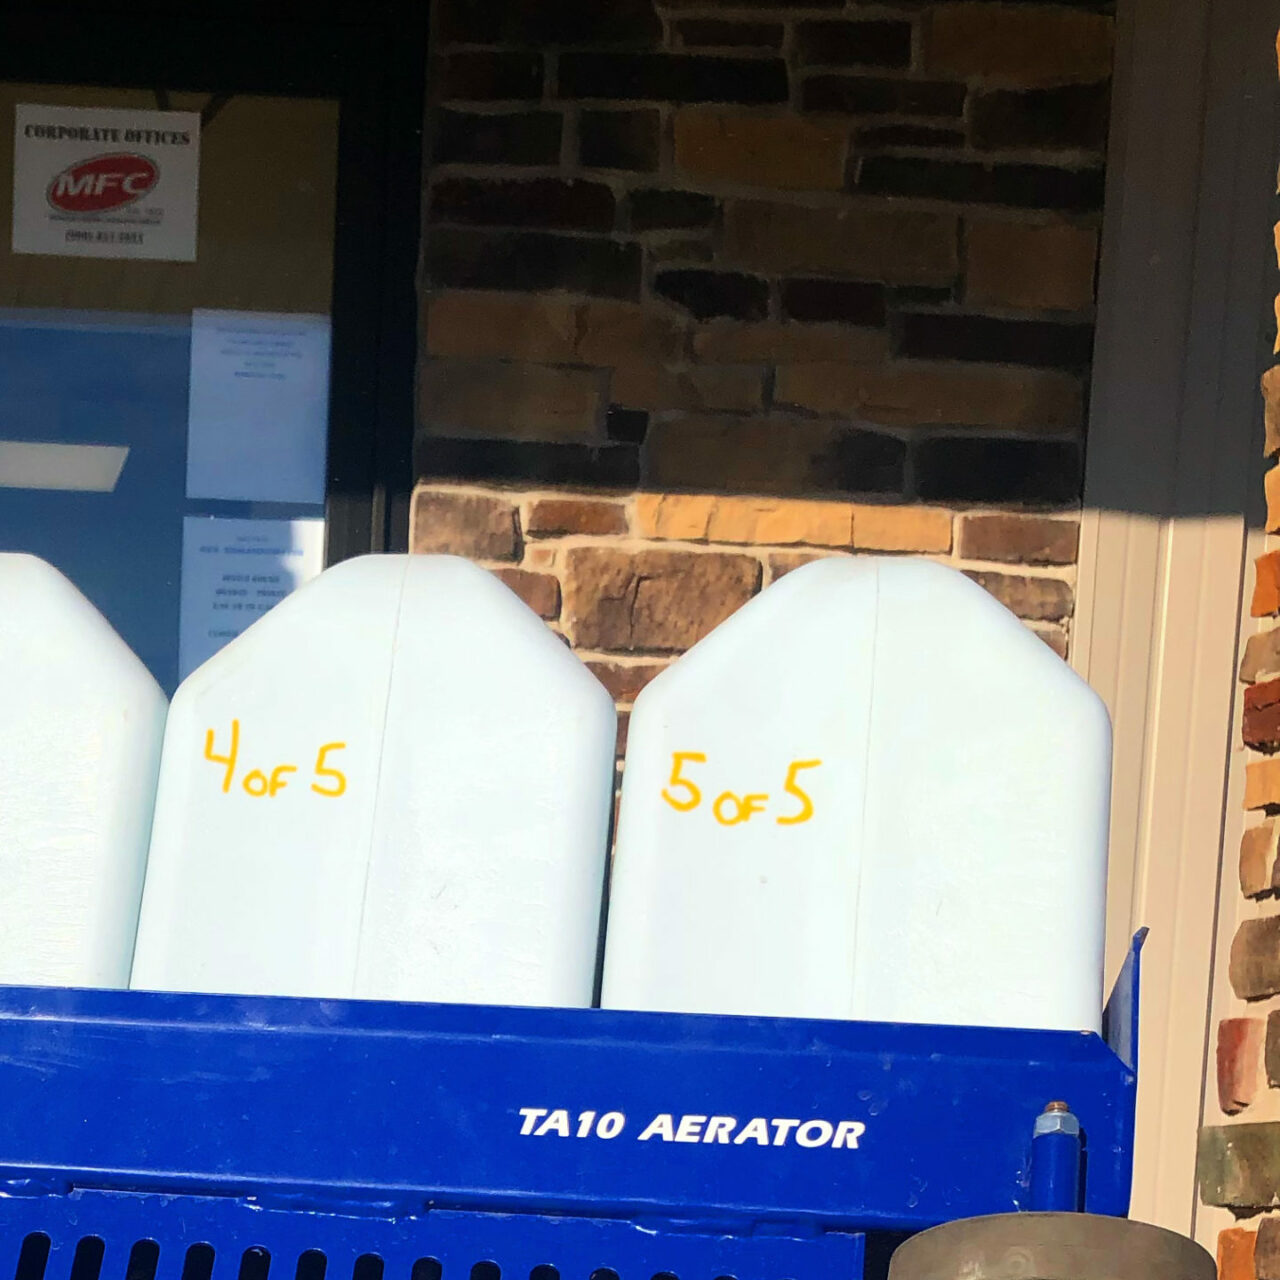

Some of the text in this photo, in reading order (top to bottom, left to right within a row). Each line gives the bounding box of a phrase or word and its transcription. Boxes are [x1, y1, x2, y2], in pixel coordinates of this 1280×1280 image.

[24, 124, 190, 146] CORPORATE OFFICES
[56, 171, 150, 197] MFC
[203, 718, 240, 795] 4
[310, 741, 347, 798] 5
[660, 751, 707, 813] 5
[775, 758, 823, 826] 5
[519, 1107, 866, 1150] TA10 AERATOR
